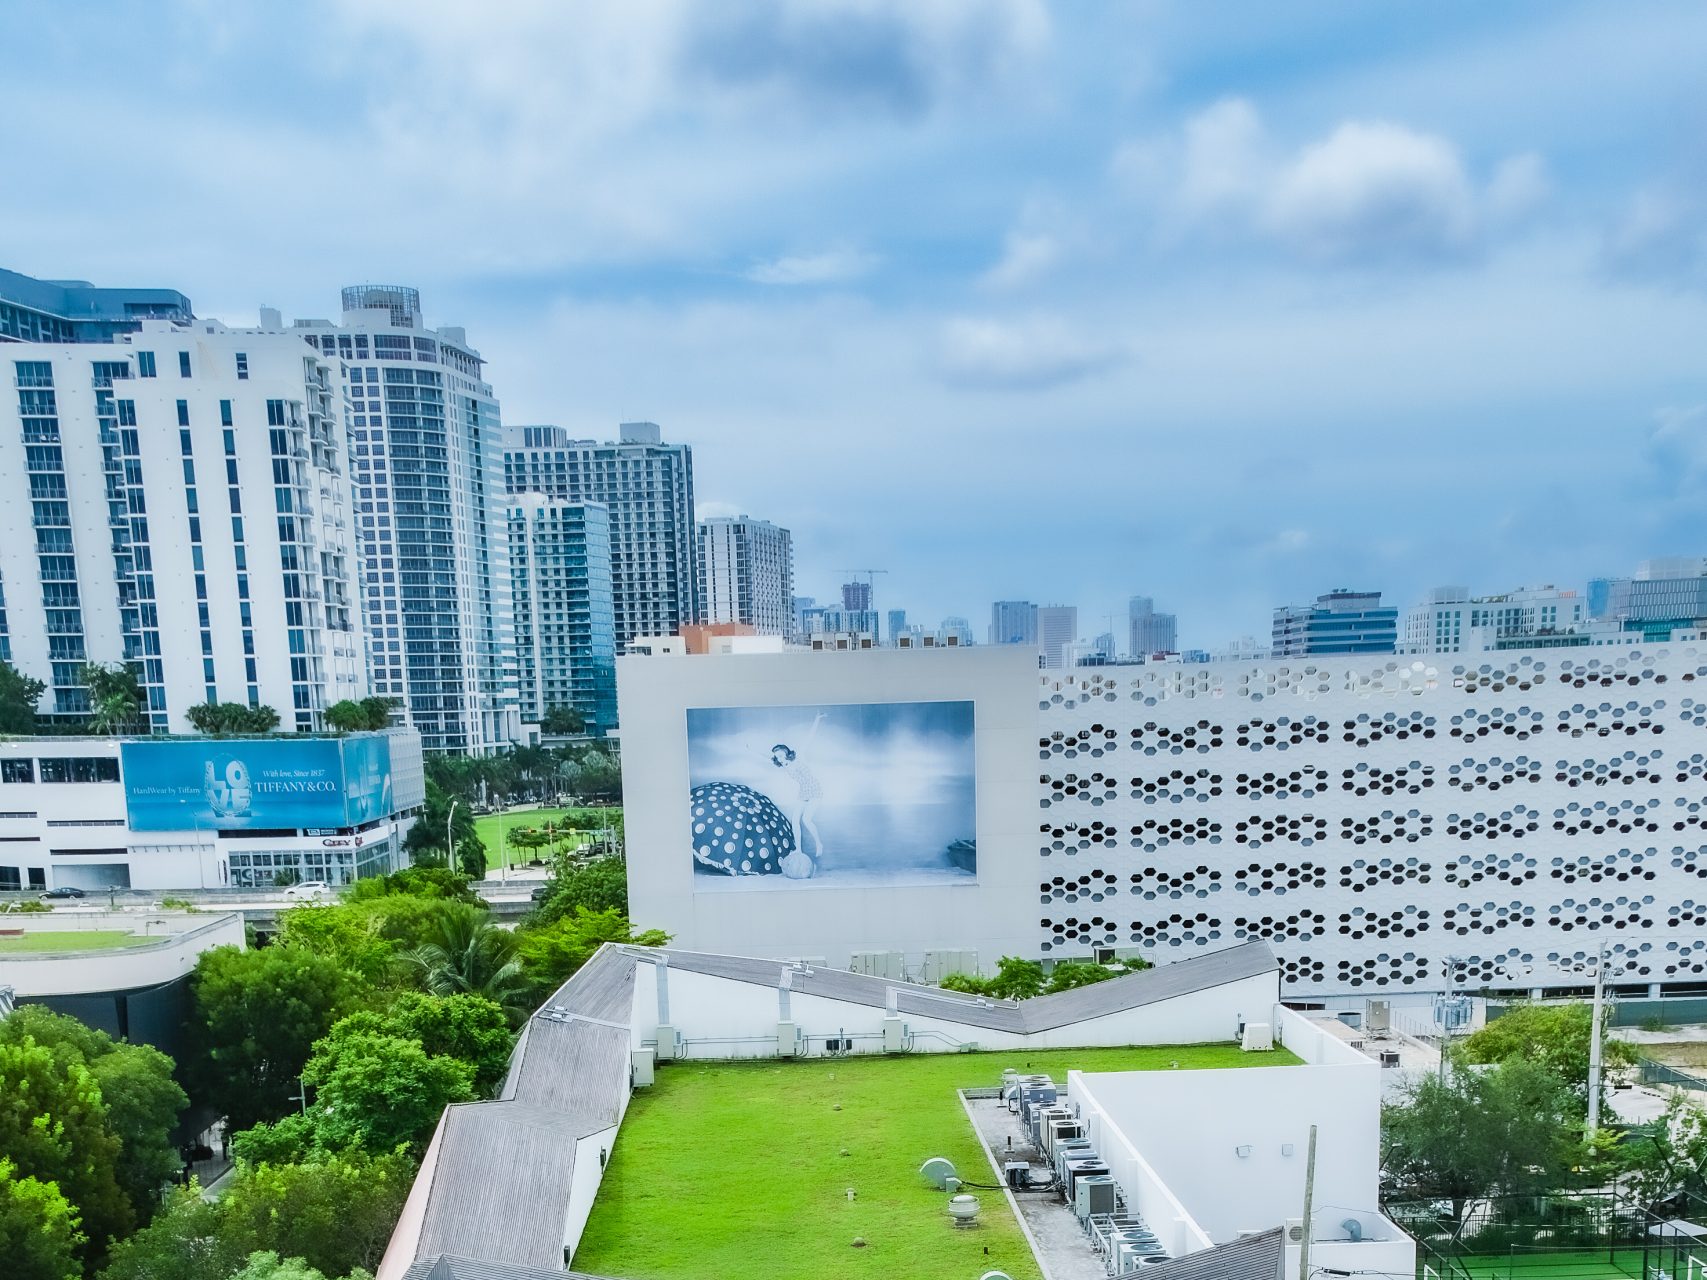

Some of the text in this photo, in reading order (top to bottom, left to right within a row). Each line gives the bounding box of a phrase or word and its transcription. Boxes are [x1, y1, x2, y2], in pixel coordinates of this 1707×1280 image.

[263, 769, 326, 778] With love, Since 1837
[133, 786, 200, 796] HardWear by Tiffany
[254, 780, 336, 793] TIFFANY&CO.
